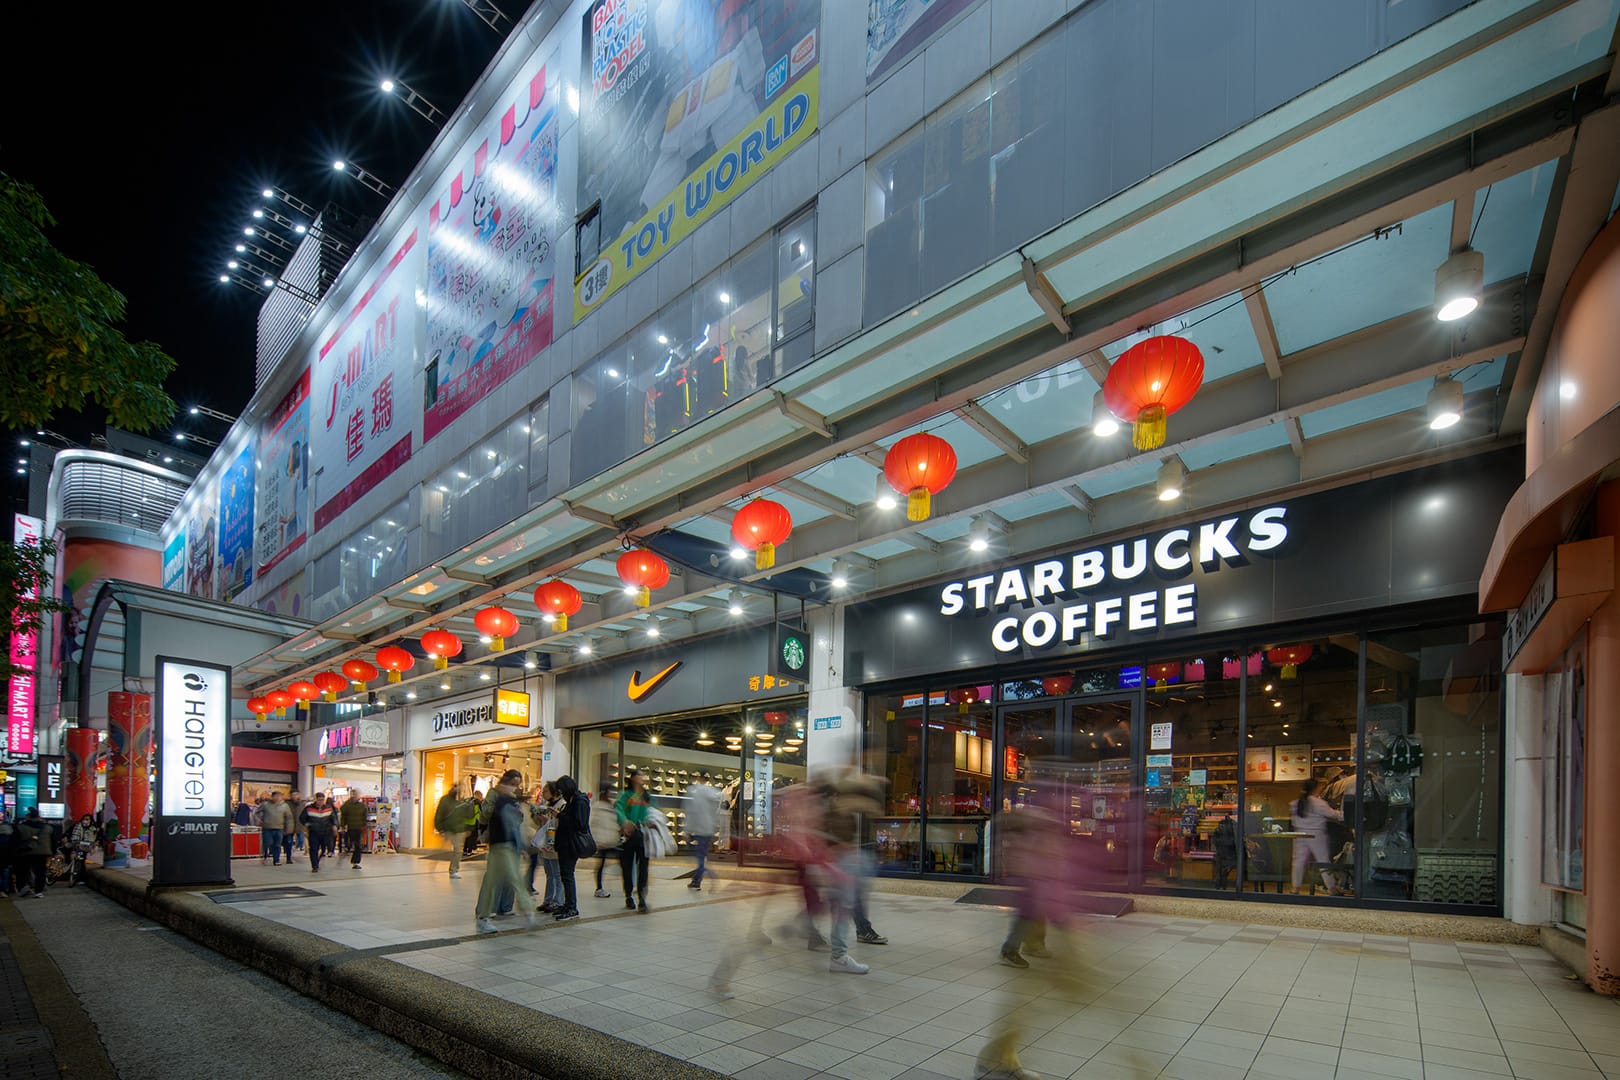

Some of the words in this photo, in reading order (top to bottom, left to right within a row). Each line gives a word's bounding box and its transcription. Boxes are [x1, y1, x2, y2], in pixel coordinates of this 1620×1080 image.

[593, 31, 646, 98] MODEL
[621, 202, 674, 271] TOY
[684, 93, 809, 219] WORLD
[584, 264, 609, 302] 3樓
[346, 371, 394, 464] 佳瑪
[940, 506, 1289, 617] STARBUCKS
[990, 583, 1197, 653] COFFEE
[47, 762, 61, 799] NET
